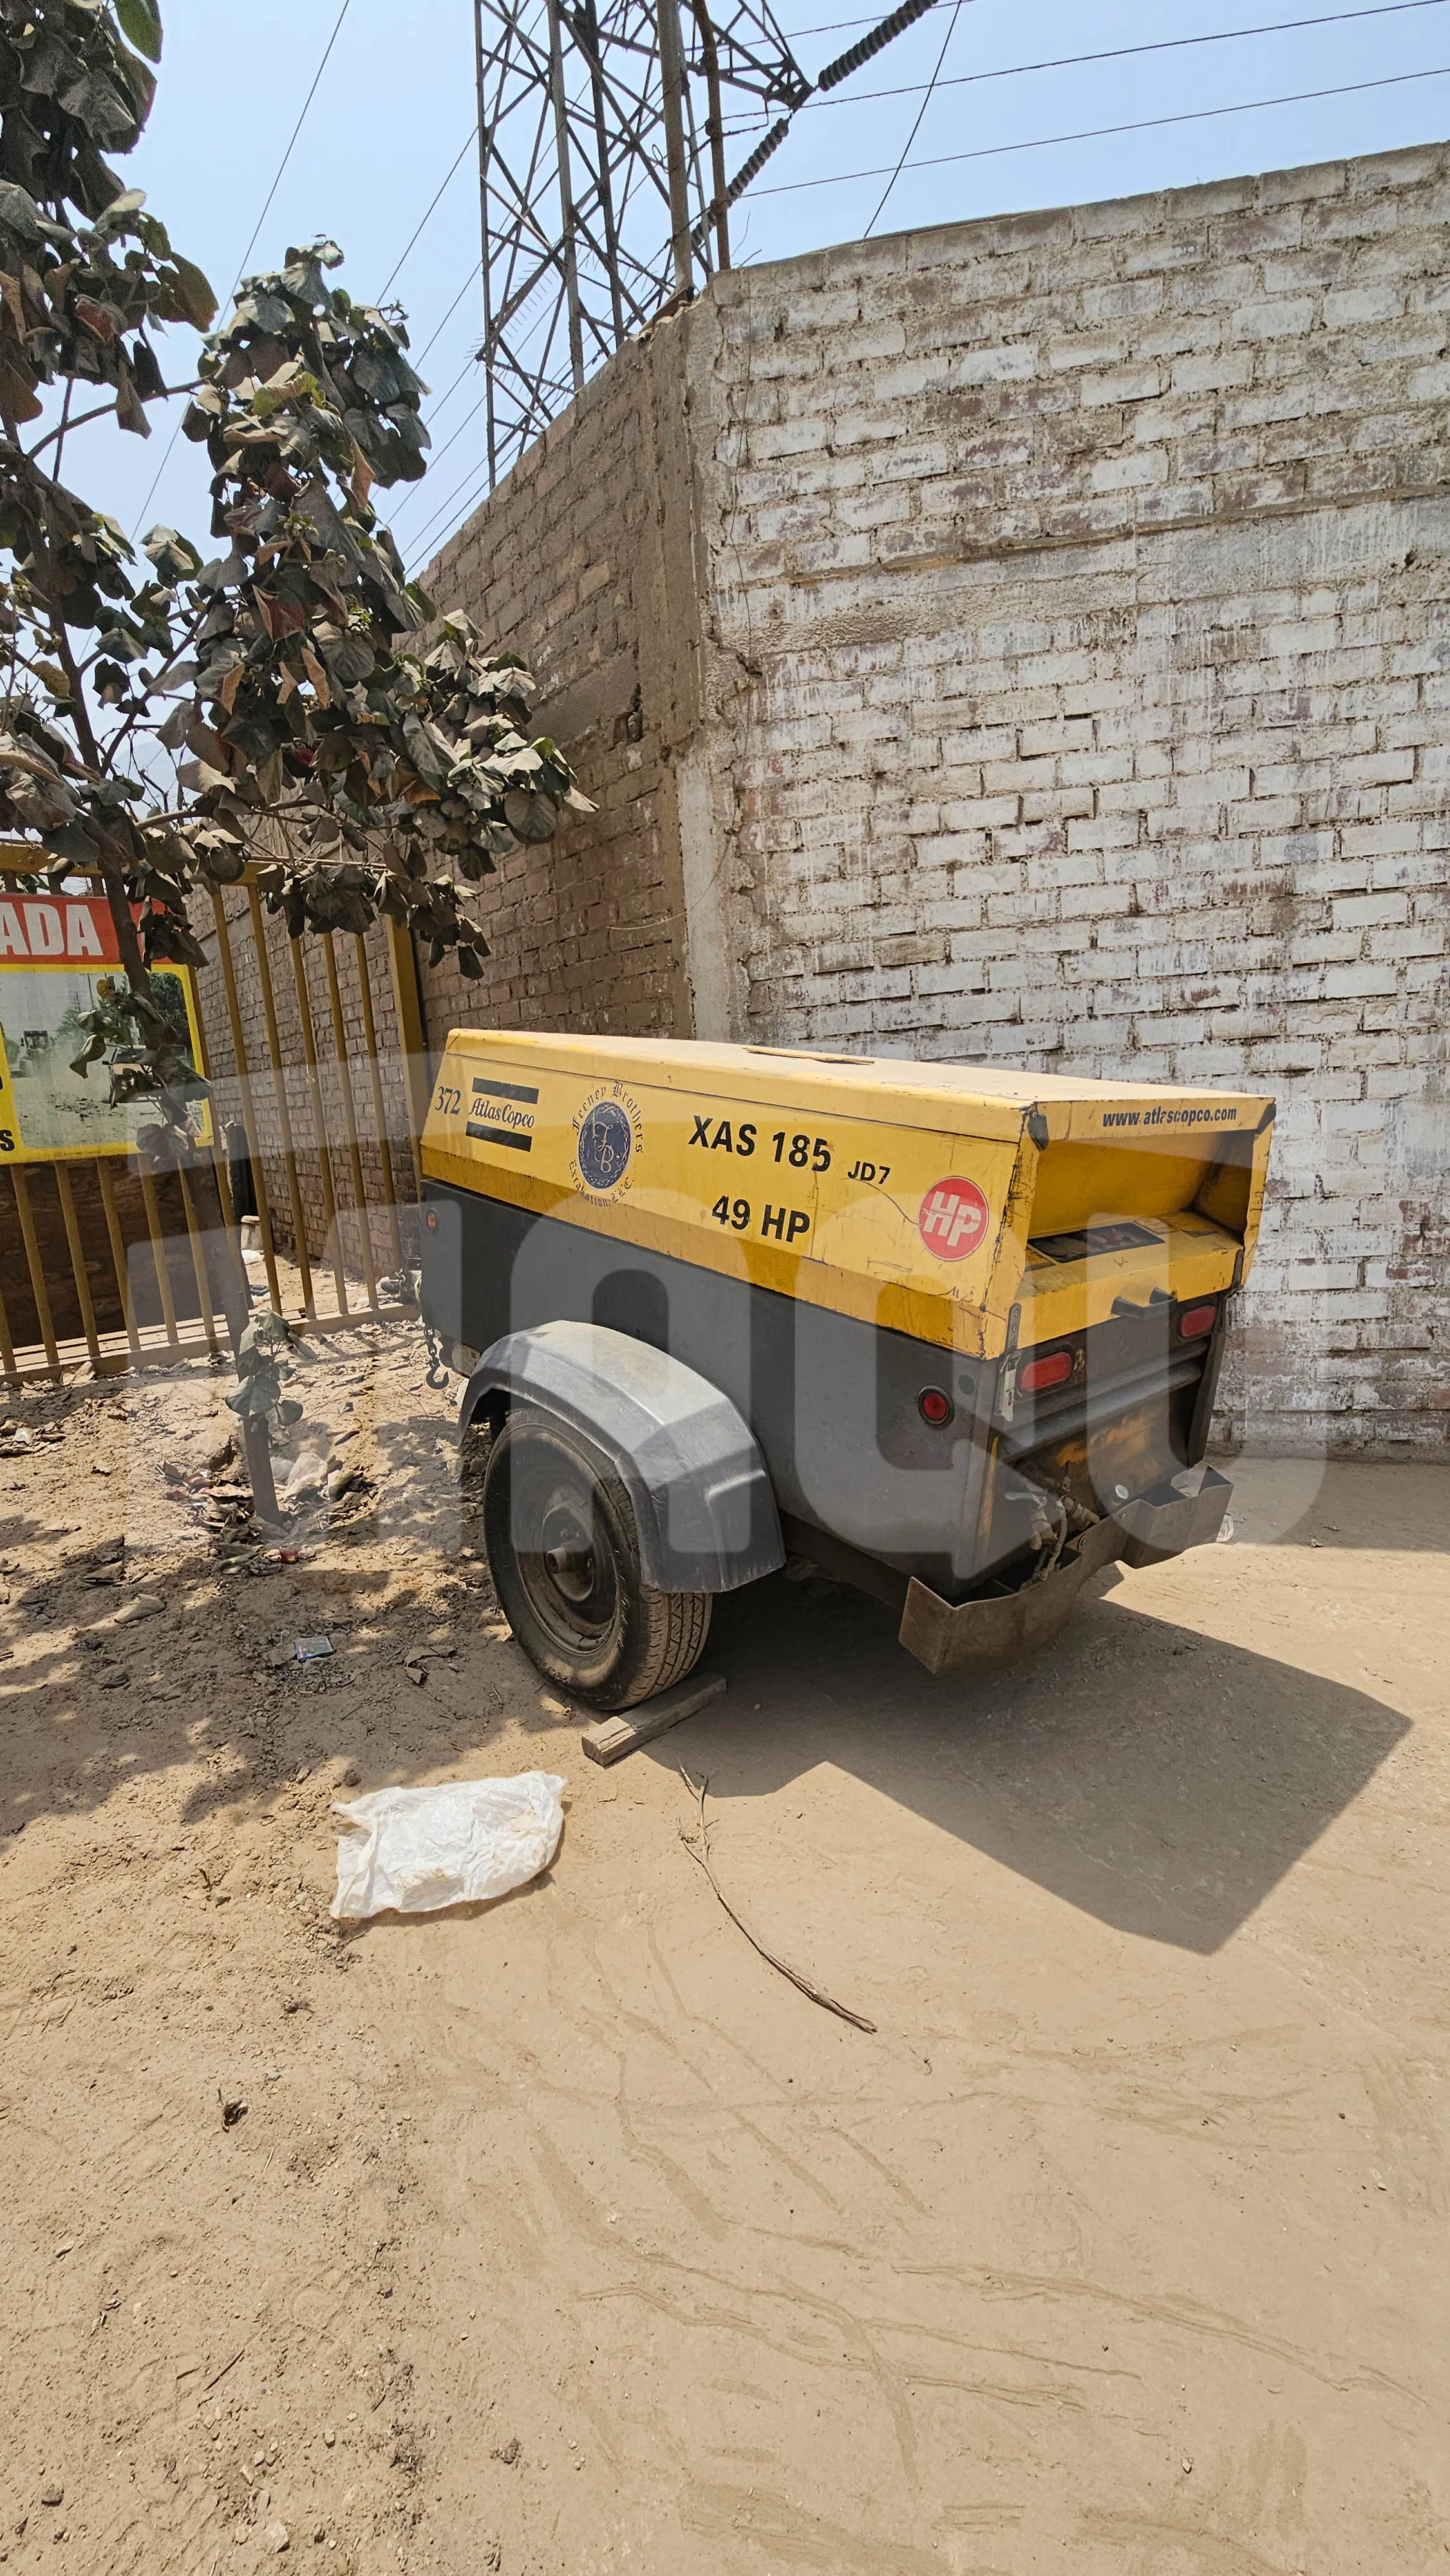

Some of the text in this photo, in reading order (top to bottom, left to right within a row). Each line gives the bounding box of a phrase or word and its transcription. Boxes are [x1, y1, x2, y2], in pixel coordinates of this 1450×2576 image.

[434, 1086, 462, 1115] 372
[572, 1080, 644, 1153] Feeney Brothers
[688, 1115, 891, 1184] XAS 185 JD7
[711, 1195, 811, 1244] 49 HP
[923, 1190, 983, 1247] HP
